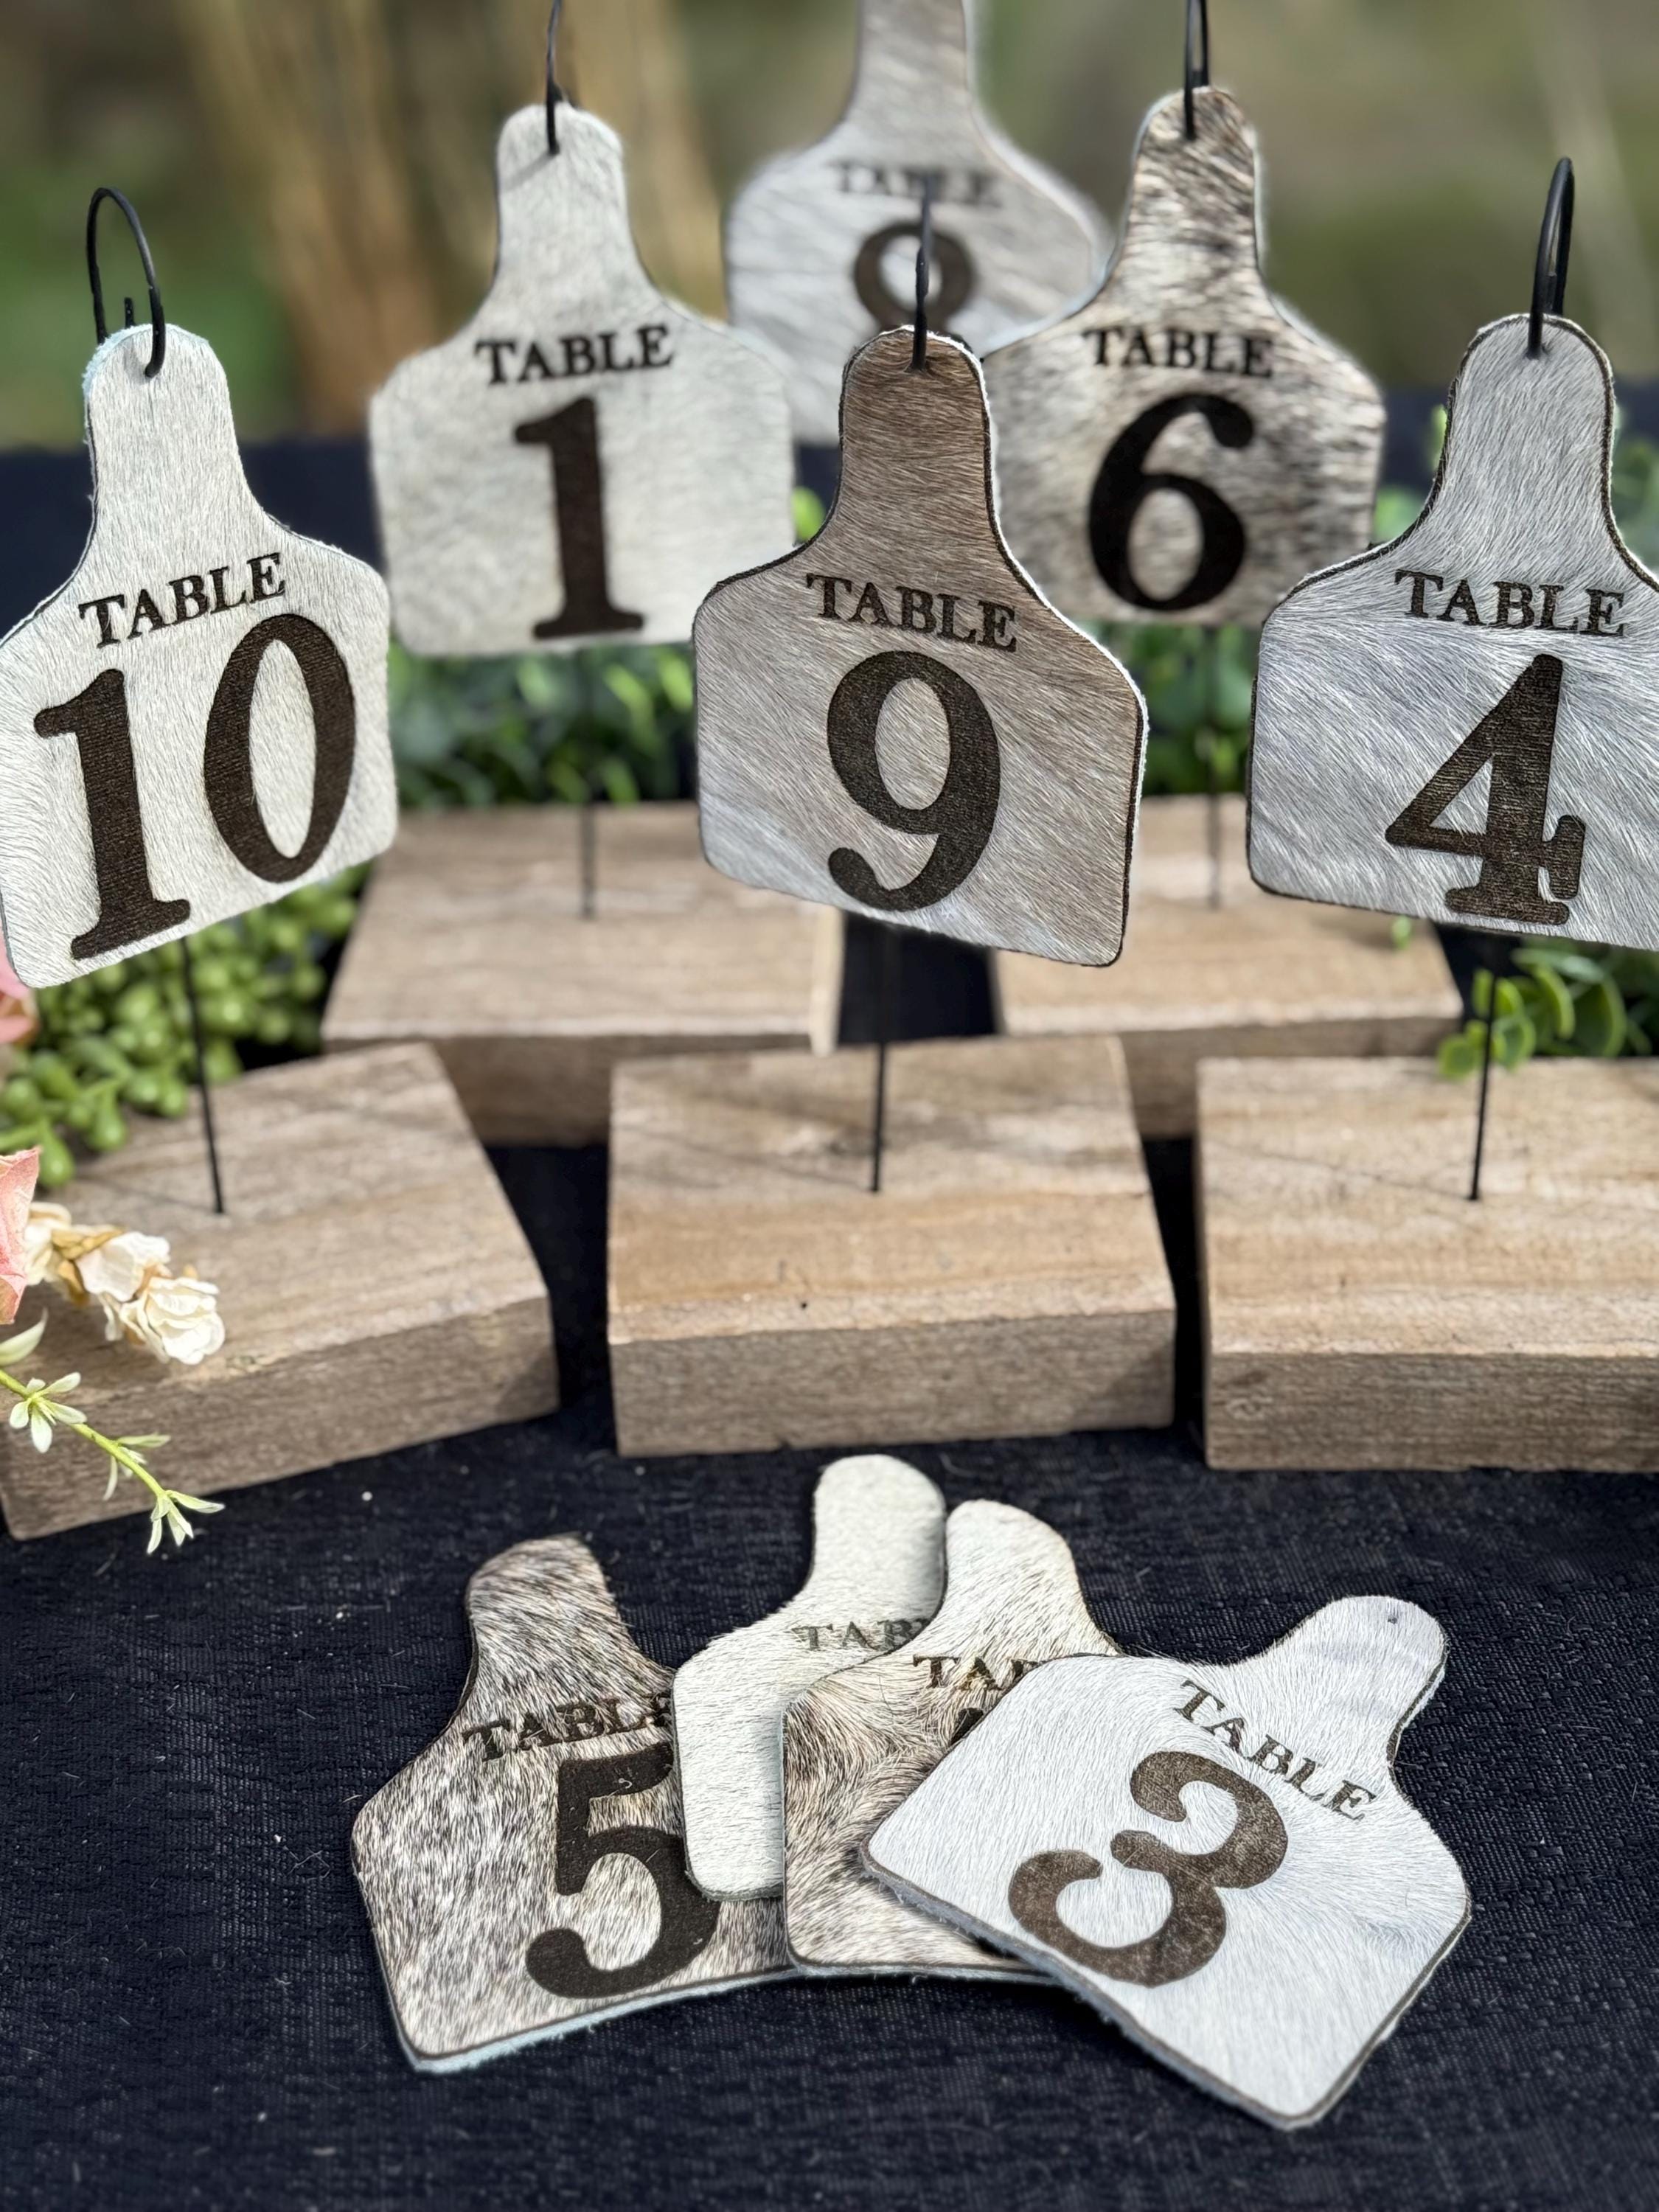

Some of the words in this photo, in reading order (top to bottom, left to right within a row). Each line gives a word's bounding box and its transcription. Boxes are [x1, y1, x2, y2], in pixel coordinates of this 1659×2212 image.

[474, 323, 673, 386] TABLE
[1083, 325, 1273, 378] TABLE
[513, 395, 644, 640] 1
[1088, 392, 1254, 611] 6
[79, 552, 286, 649] TABLE
[806, 572, 1017, 653] TABLE
[1395, 569, 1624, 636] TABLE
[33, 613, 355, 960] 10
[827, 650, 1001, 912] 9
[1385, 654, 1586, 925] 4
[791, 1618, 931, 1652] TAB
[1174, 1679, 1376, 1820] TABLE
[525, 1742, 720, 1999] 5
[1008, 1750, 1288, 1989] 3
